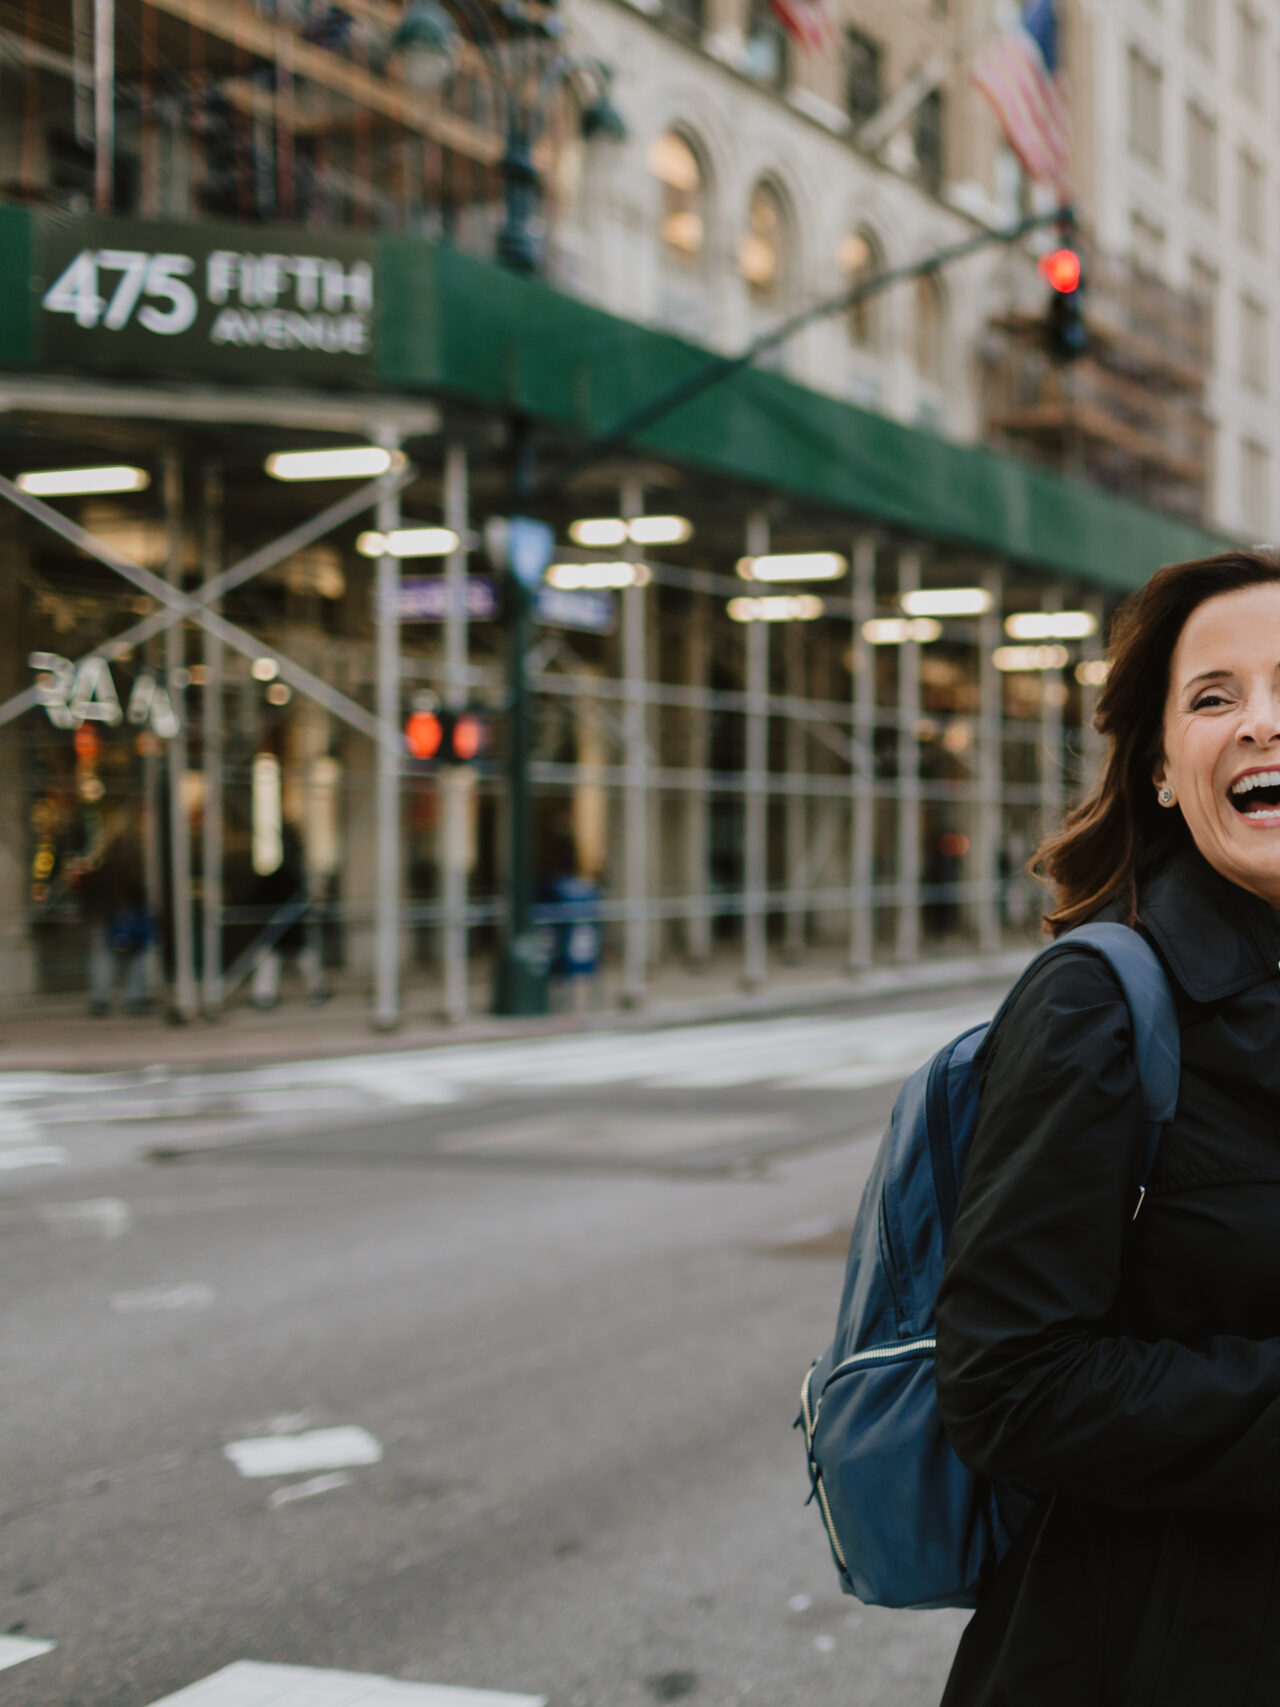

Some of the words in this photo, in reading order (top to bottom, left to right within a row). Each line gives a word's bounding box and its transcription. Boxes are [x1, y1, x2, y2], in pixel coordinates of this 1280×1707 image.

[42, 247, 199, 336] 475
[206, 249, 375, 314] FIFTH
[208, 306, 374, 356] AVENUE
